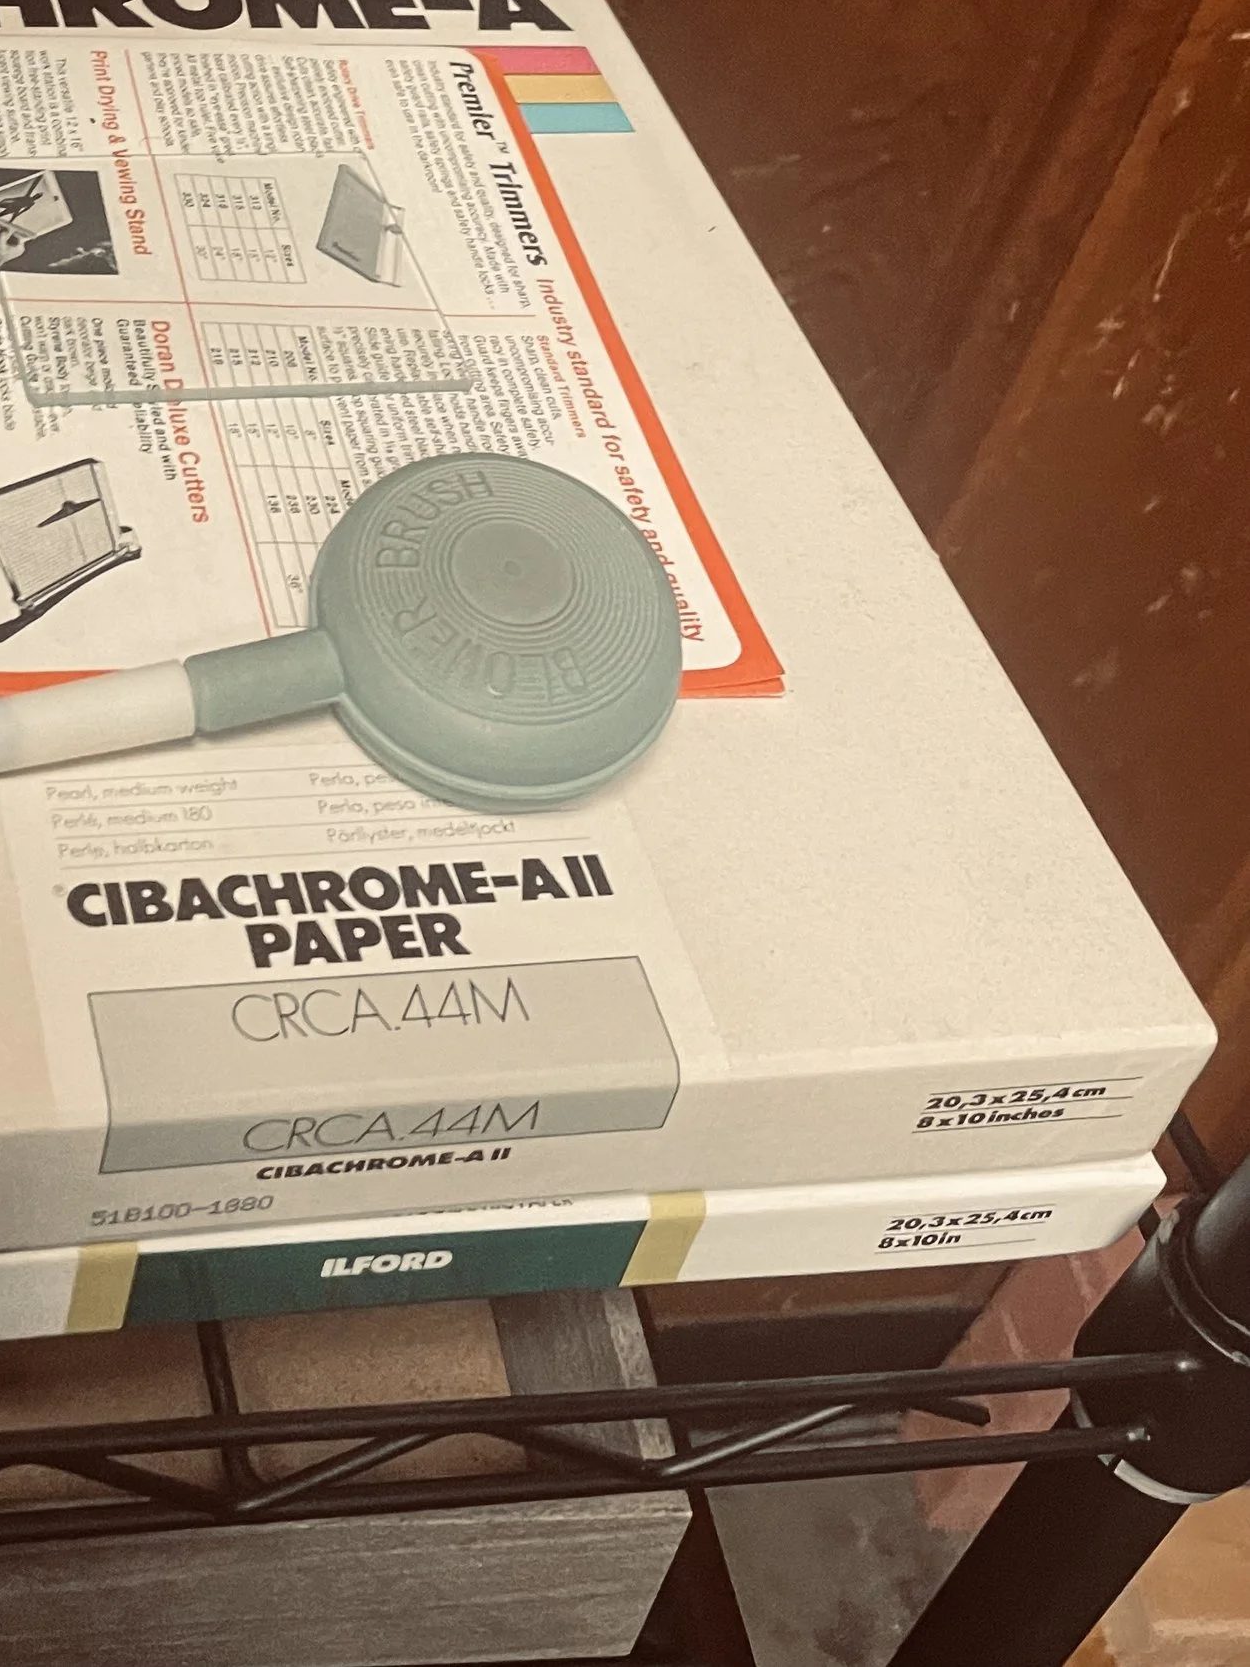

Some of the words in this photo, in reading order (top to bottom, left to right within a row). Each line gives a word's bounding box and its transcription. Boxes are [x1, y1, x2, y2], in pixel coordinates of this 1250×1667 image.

[88, 50, 113, 81] Print
[93, 85, 123, 129] Drying
[107, 134, 126, 144] &
[123, 208, 153, 254] Stand
[487, 161, 555, 265] Trimmers
[532, 279, 580, 345] Industry
[114, 319, 143, 386] Guaranteed
[130, 319, 159, 381] Beautifully
[502, 335, 547, 415] uncompromising
[472, 335, 495, 364] Guard
[494, 399, 520, 432] fingers
[500, 369, 529, 414] complete
[532, 367, 554, 393] clean
[536, 335, 566, 382] Standard
[556, 385, 589, 437] Trimmers
[565, 351, 615, 427] standard
[149, 320, 180, 372] Doran
[176, 452, 213, 523] Cutters
[154, 429, 171, 450] and
[487, 421, 513, 454] Safety
[600, 435, 630, 461] for
[159, 455, 178, 481] with
[608, 466, 655, 522] safety
[377, 470, 495, 568] BRUSH
[66, 857, 569, 927] CIBACHROME-A
[245, 912, 471, 968] PAPER
[231, 977, 530, 1043] CRCA.44M
[243, 1099, 540, 1153] CRCA.44M
[255, 1150, 486, 1181] CIBACHROME-A
[320, 1248, 454, 1278] ILFORD
